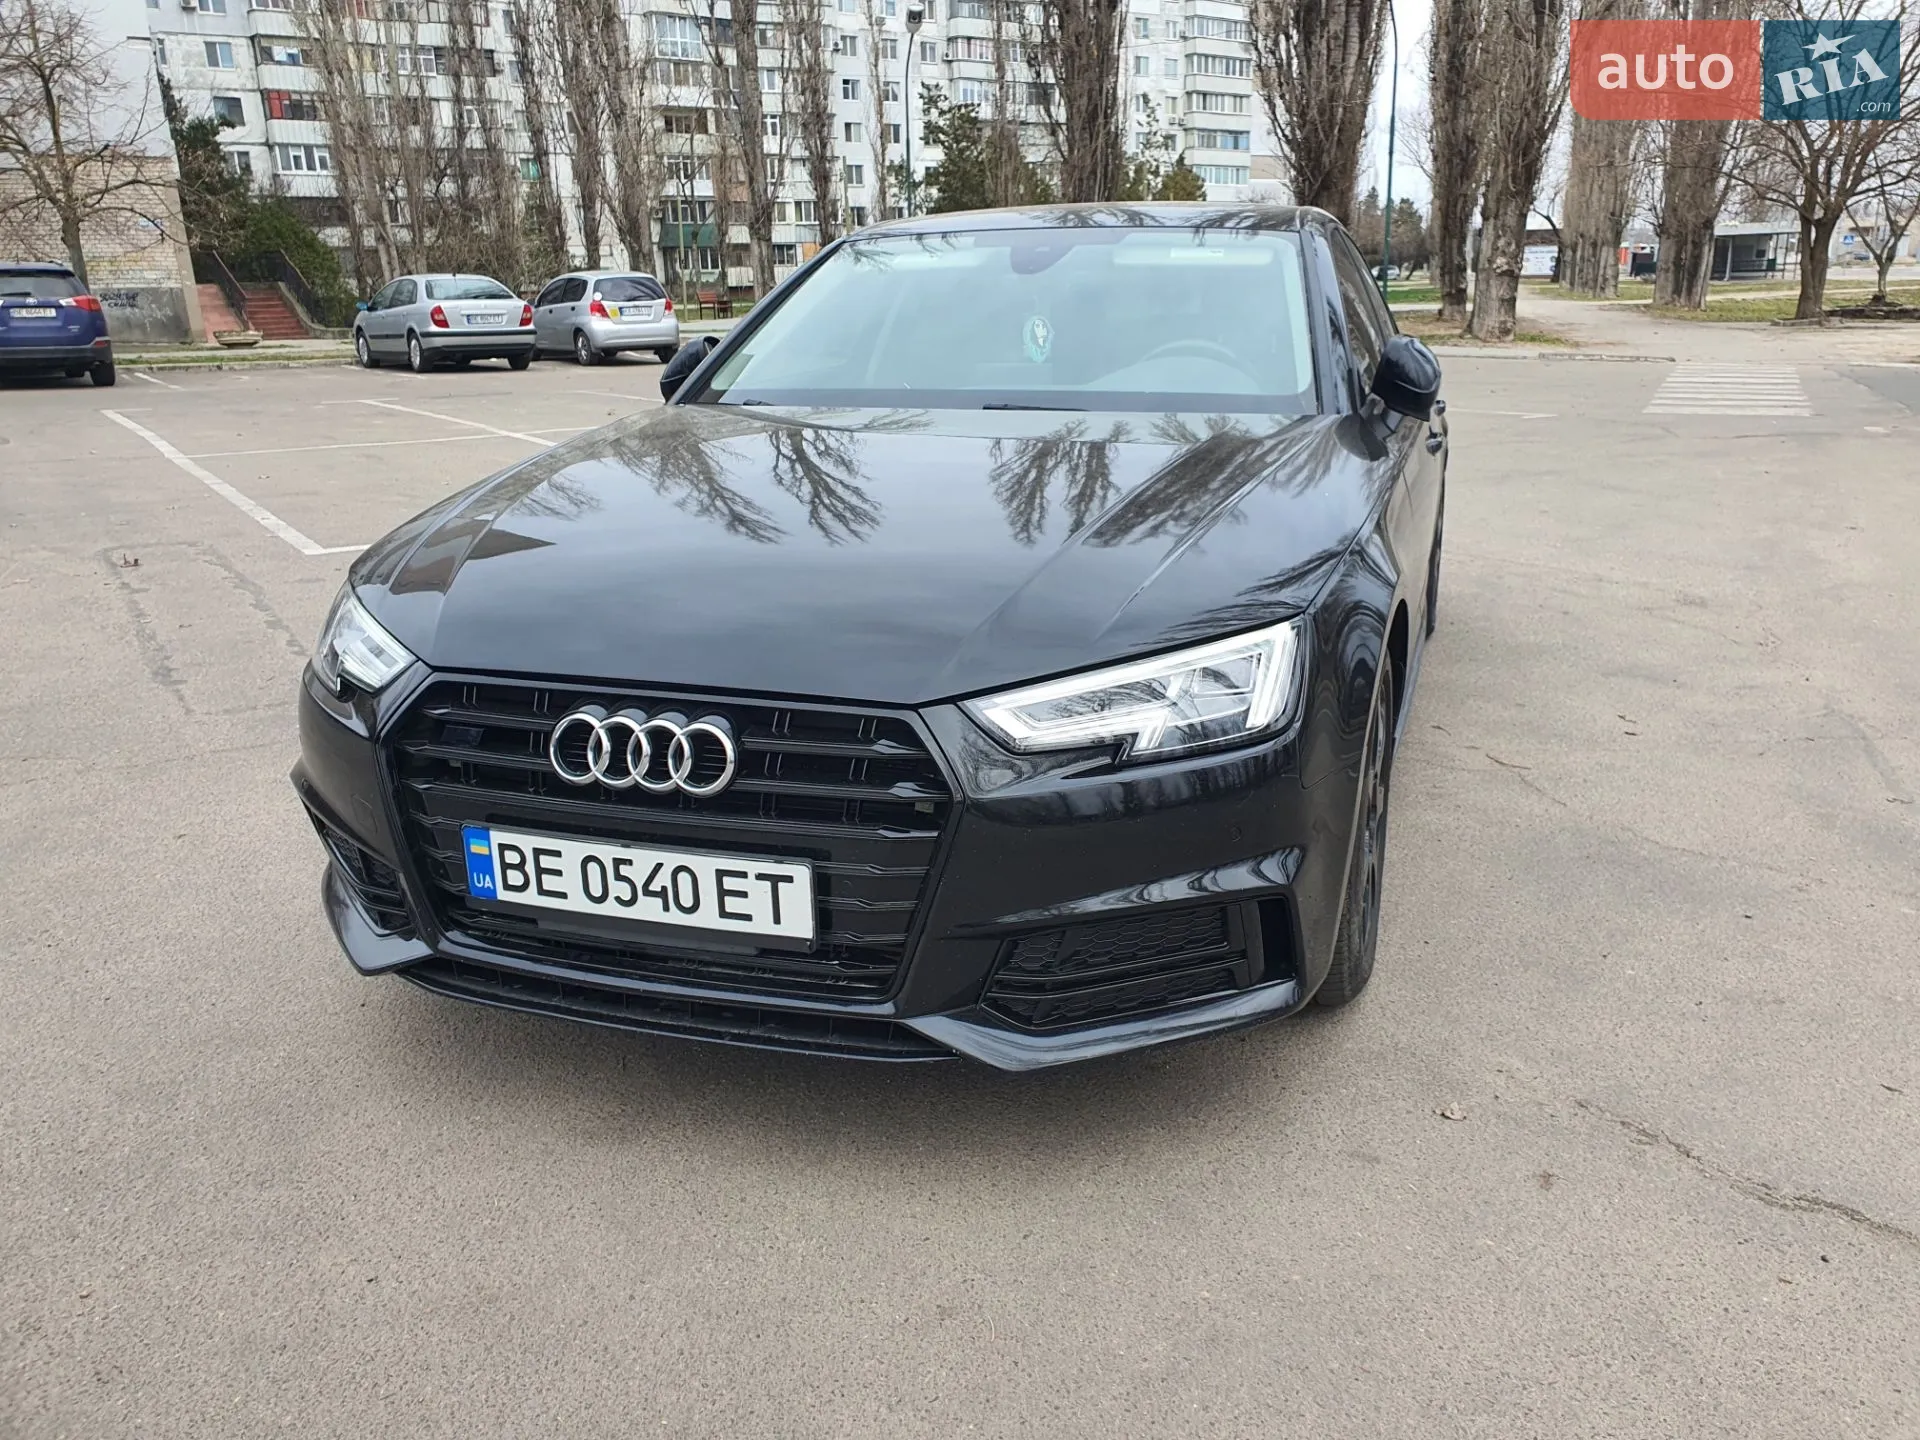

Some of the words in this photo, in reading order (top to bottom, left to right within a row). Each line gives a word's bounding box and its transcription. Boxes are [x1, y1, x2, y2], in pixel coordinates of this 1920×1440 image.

[473, 872, 494, 890] UA
[497, 842, 568, 900] BE
[580, 854, 700, 915] 0540
[715, 868, 794, 925] ET
